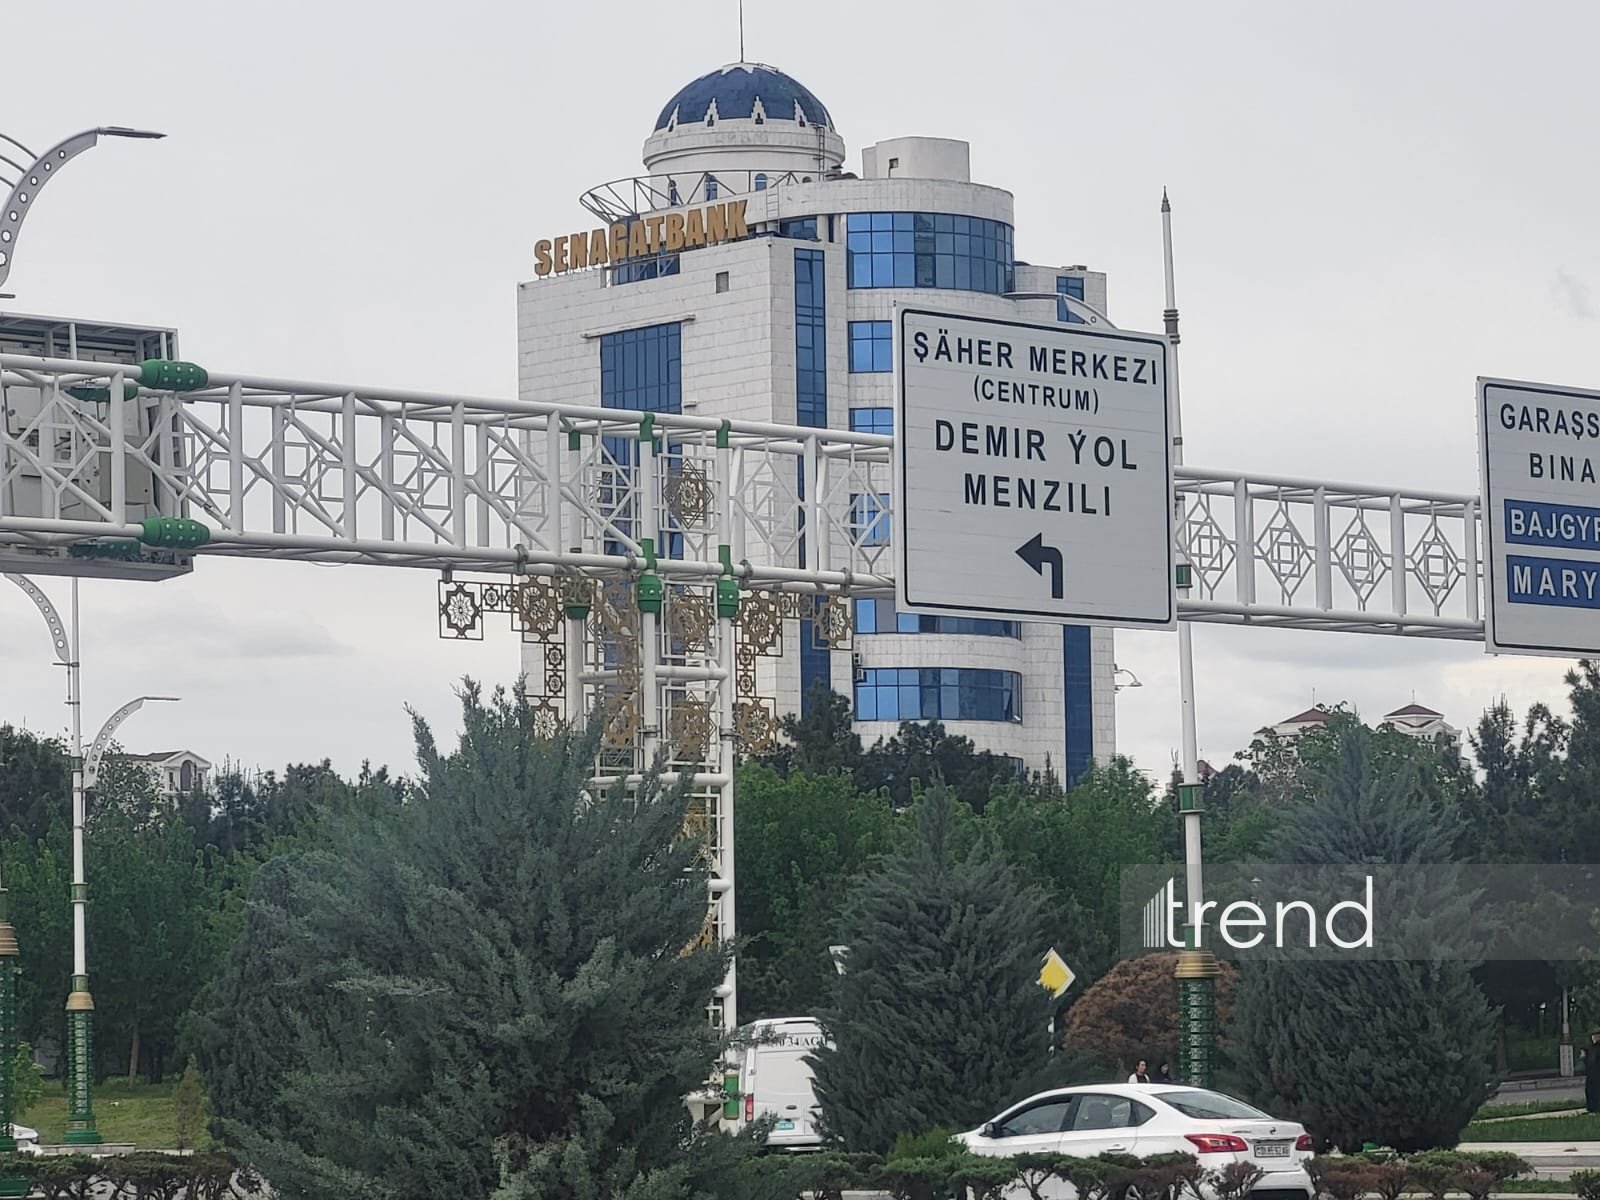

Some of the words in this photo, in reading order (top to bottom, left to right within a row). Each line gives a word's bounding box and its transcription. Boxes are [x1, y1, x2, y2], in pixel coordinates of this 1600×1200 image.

[534, 200, 748, 276] SENAGATBANK
[913, 329, 1014, 369] ŞÄHER
[1029, 346, 1157, 385] MERKEZI
[974, 375, 1099, 414] (CENTRUM)
[935, 420, 1046, 461] DEMIR
[1068, 429, 1137, 470] ÝOL
[1530, 453, 1596, 483] BINA
[964, 473, 1111, 516] MENZILI
[1513, 565, 1599, 600] MARY
